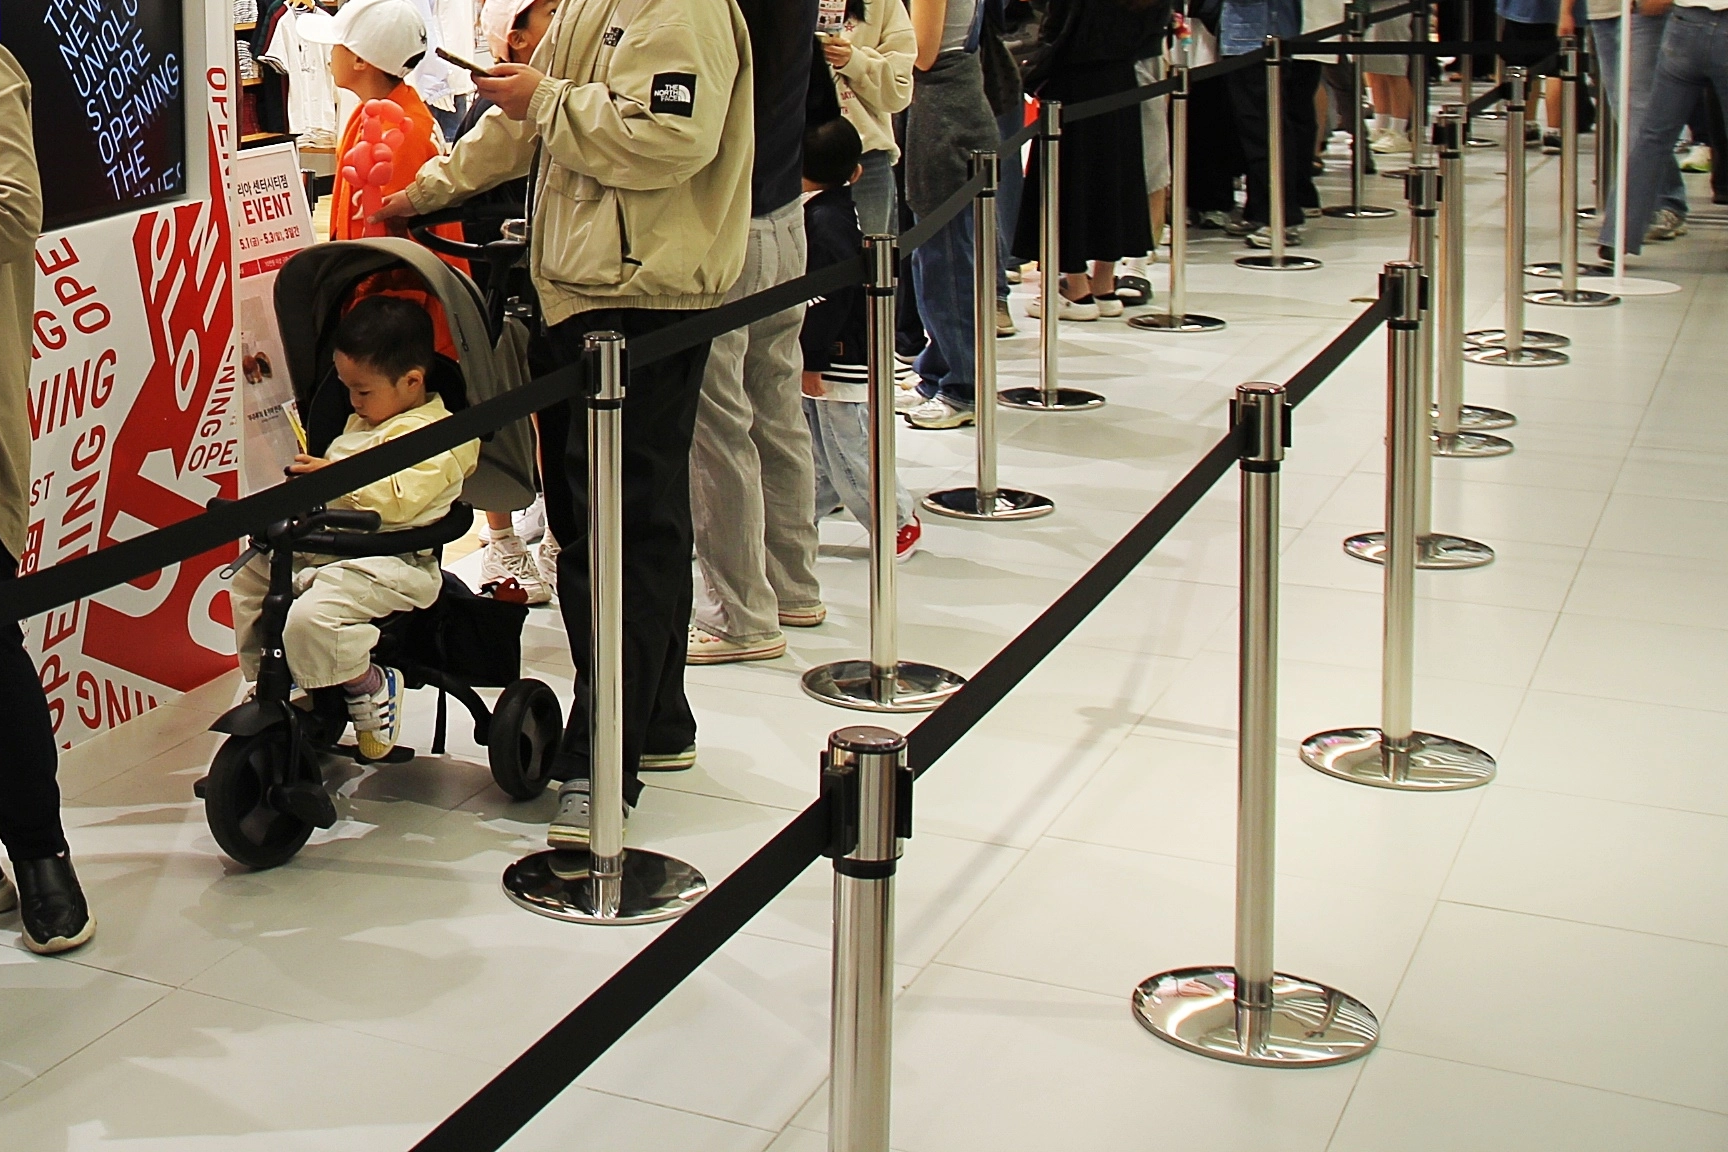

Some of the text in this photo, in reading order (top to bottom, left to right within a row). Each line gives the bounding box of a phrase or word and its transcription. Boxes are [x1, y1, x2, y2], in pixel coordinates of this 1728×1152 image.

[86, 28, 151, 131] STORE
[654, 89, 679, 97] NORTH
[98, 52, 180, 164] OPENING
[107, 139, 151, 201] THE
[242, 192, 293, 225] EVENT
[187, 439, 239, 472] OPE
